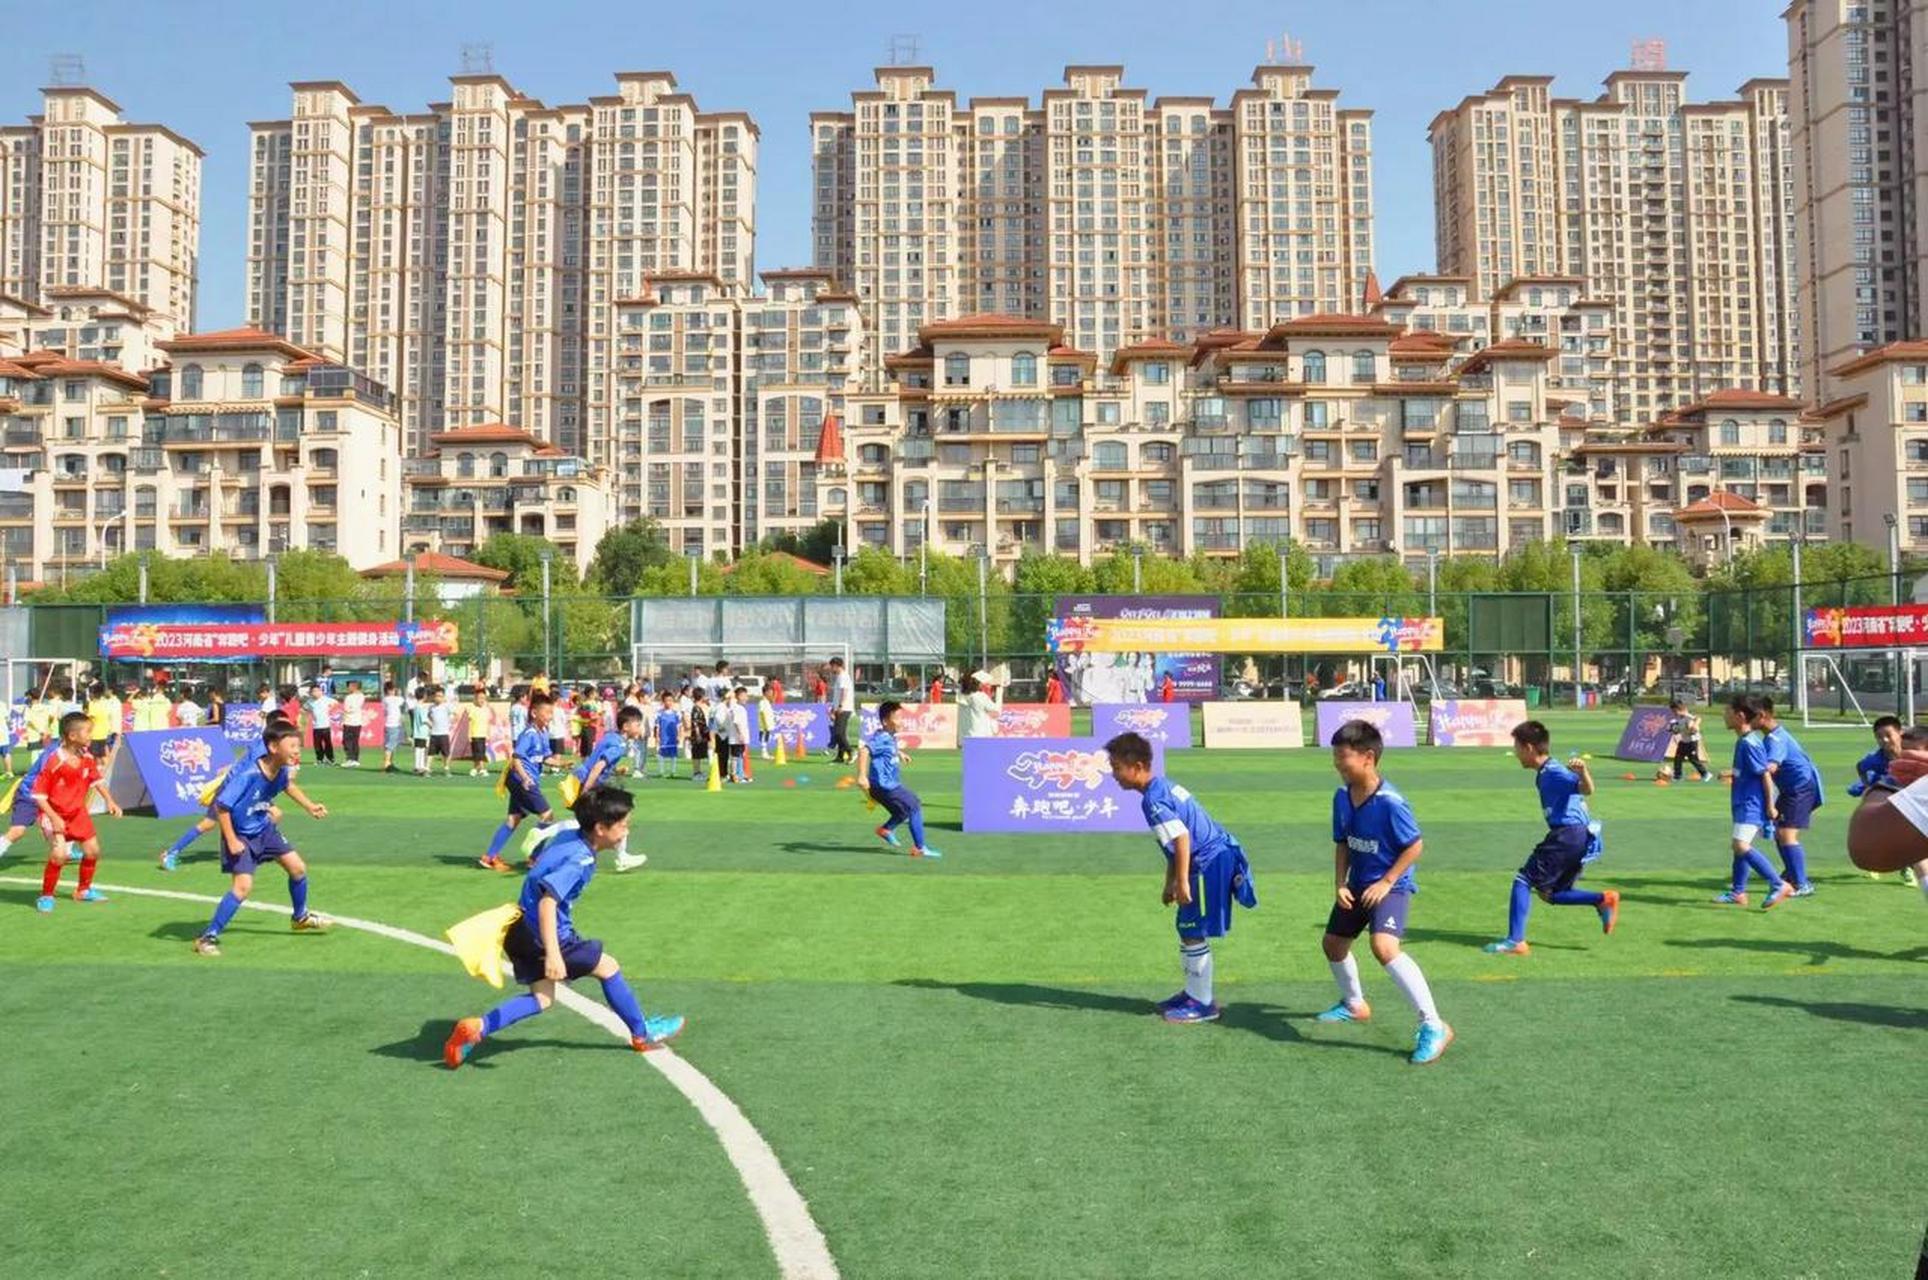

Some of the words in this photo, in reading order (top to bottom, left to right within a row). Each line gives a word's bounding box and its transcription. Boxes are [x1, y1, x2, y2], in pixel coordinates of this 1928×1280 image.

[1010, 795, 1119, 819] 奔跑吧·少年
